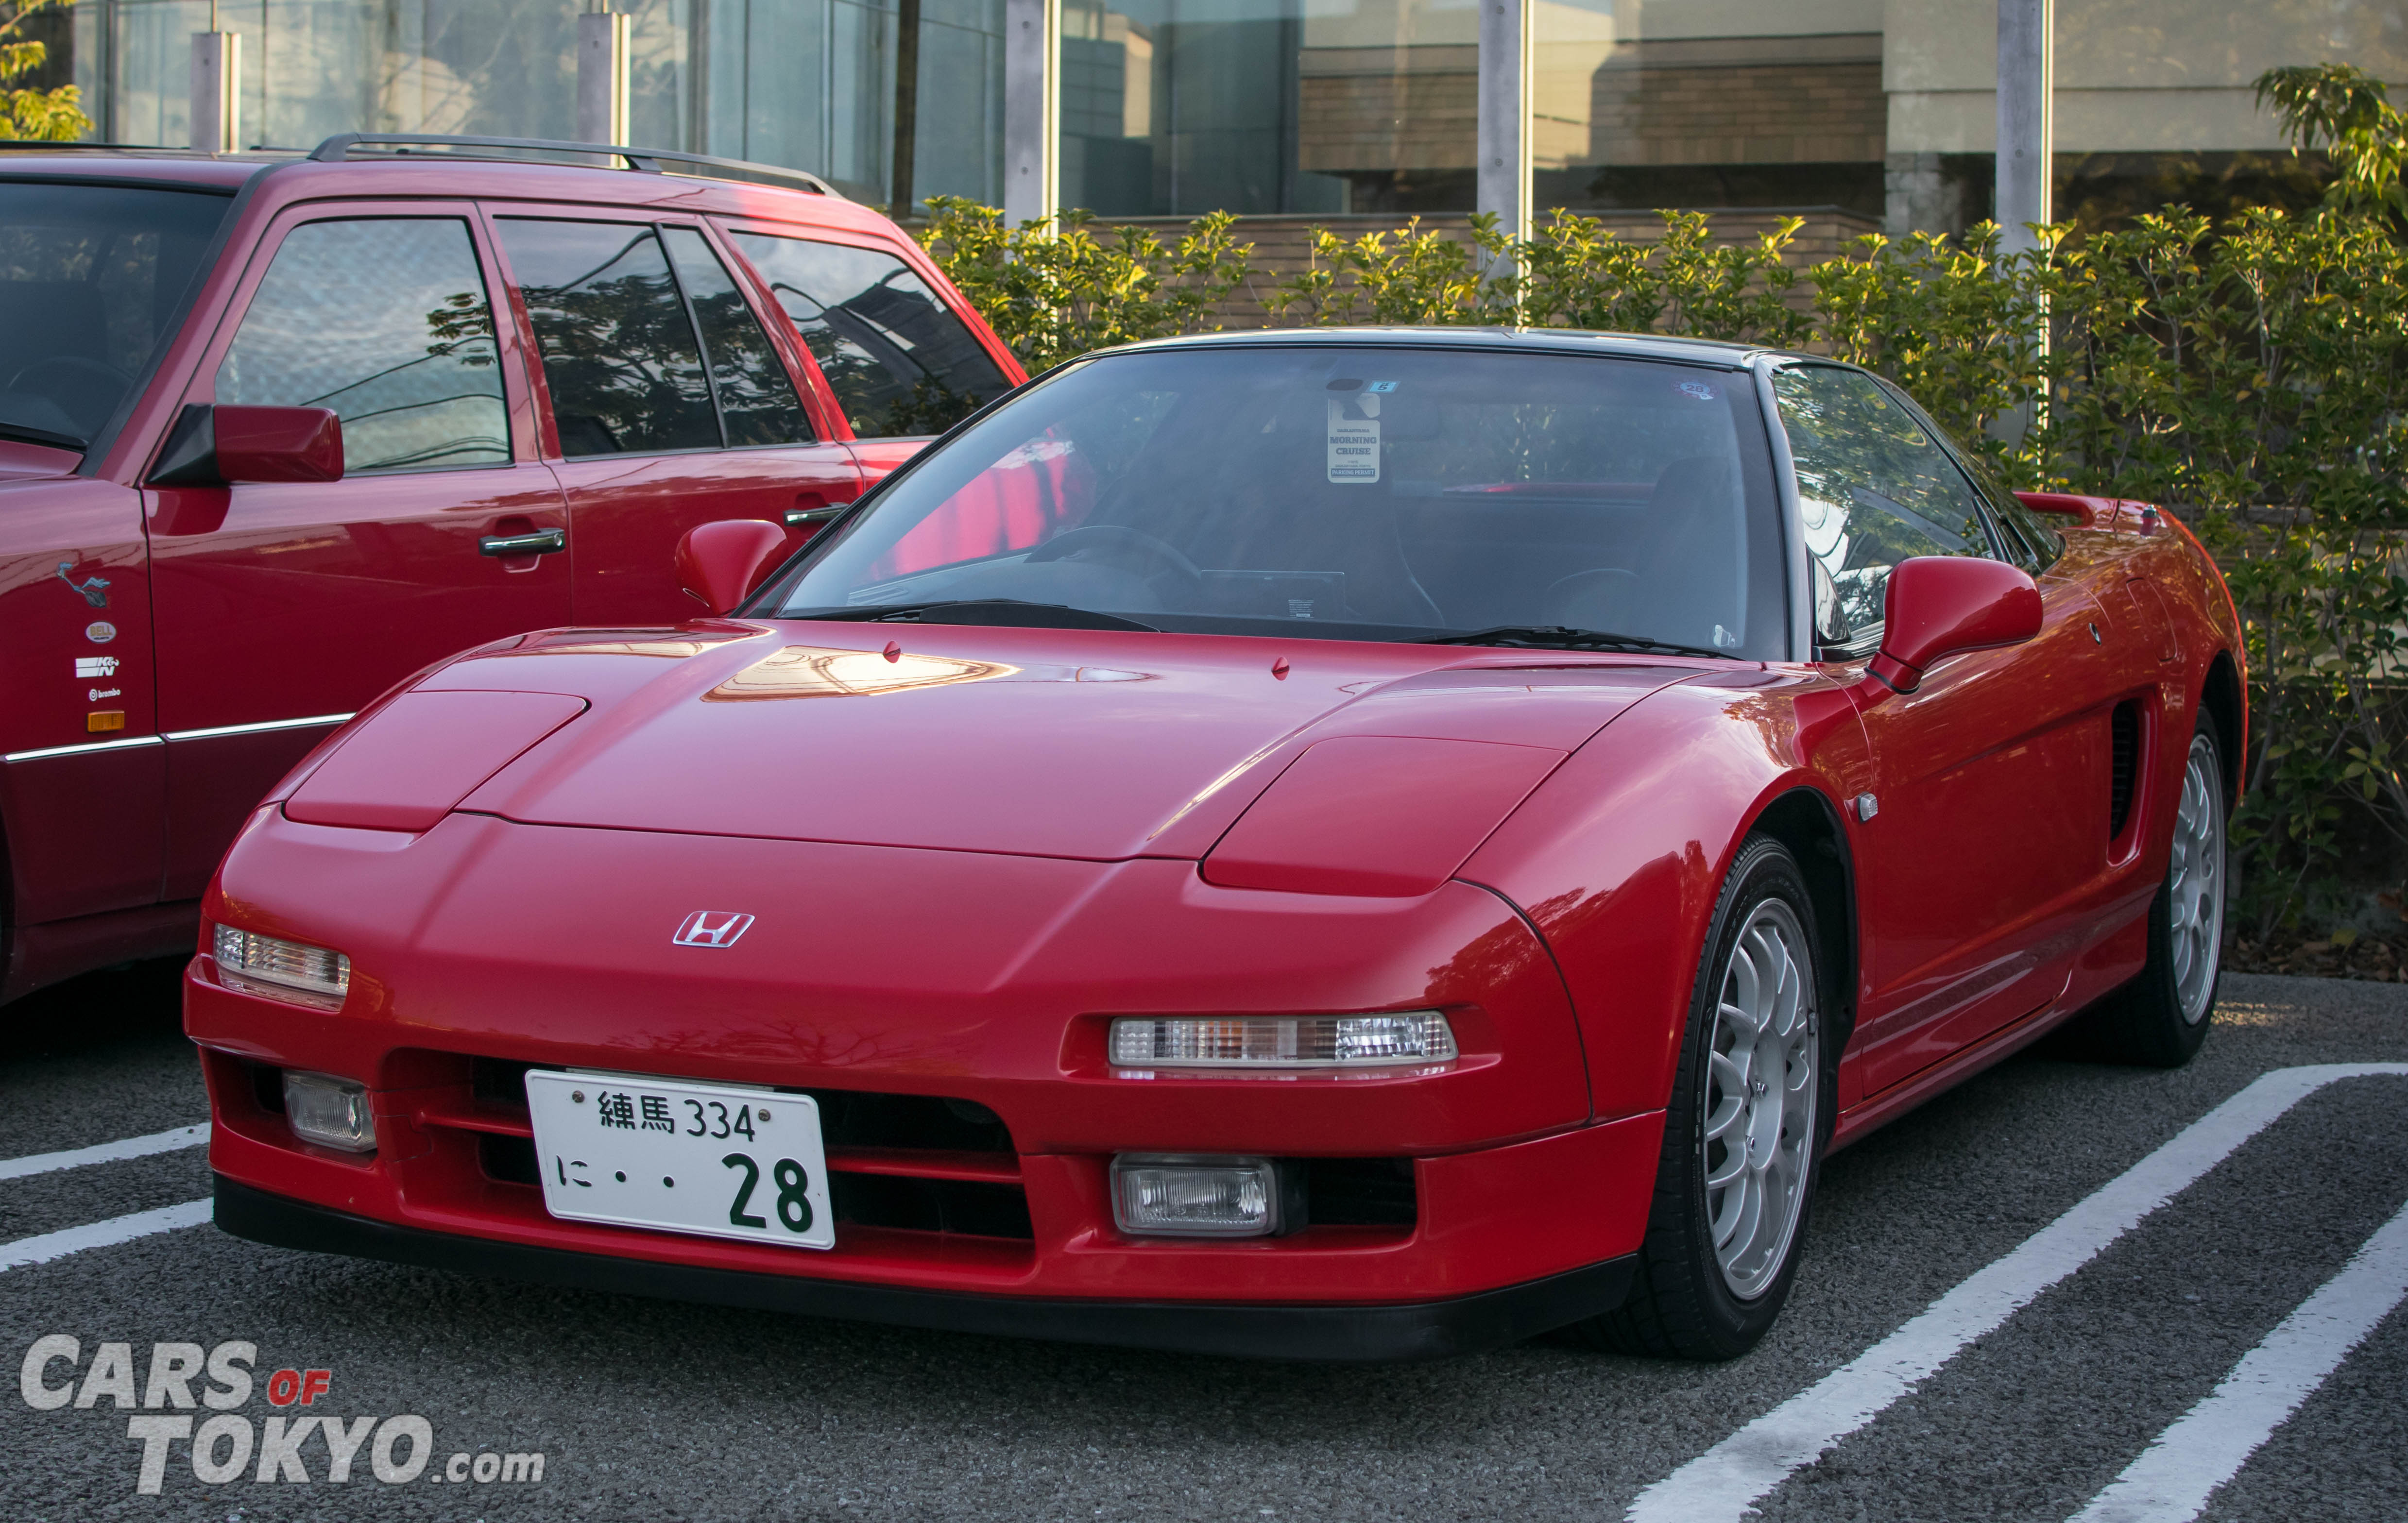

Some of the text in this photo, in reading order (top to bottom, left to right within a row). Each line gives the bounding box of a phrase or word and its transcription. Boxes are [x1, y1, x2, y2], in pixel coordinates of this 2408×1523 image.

[1686, 384, 1704, 392] 28
[90, 626, 113, 636] BELL
[98, 688, 120, 698] brembo
[597, 1090, 755, 1142] 練馬 334
[556, 1154, 593, 1187] に
